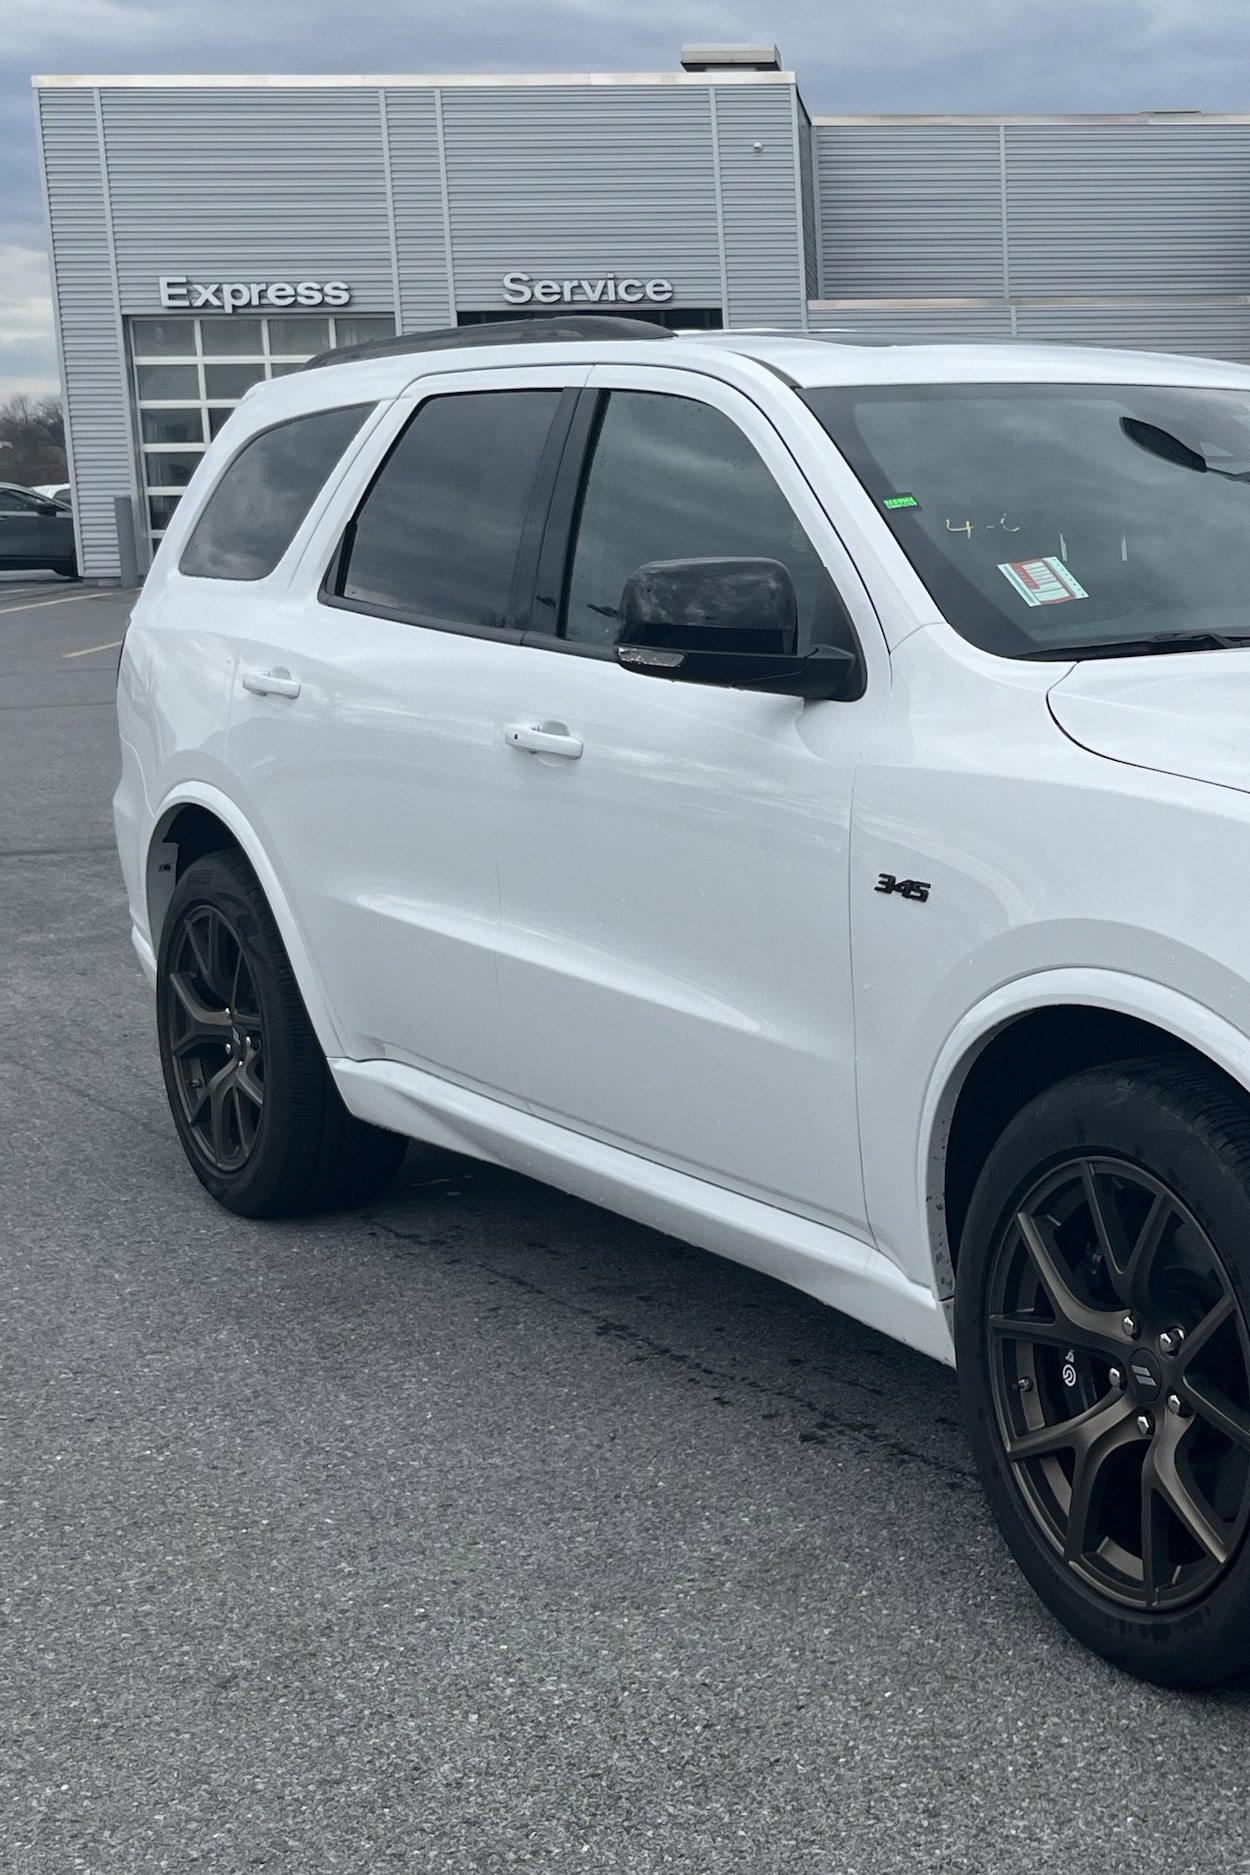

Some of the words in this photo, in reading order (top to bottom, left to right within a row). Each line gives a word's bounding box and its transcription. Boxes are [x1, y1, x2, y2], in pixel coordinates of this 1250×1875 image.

[158, 275, 351, 315] Express
[502, 271, 674, 305] Service
[873, 872, 932, 904] 345
